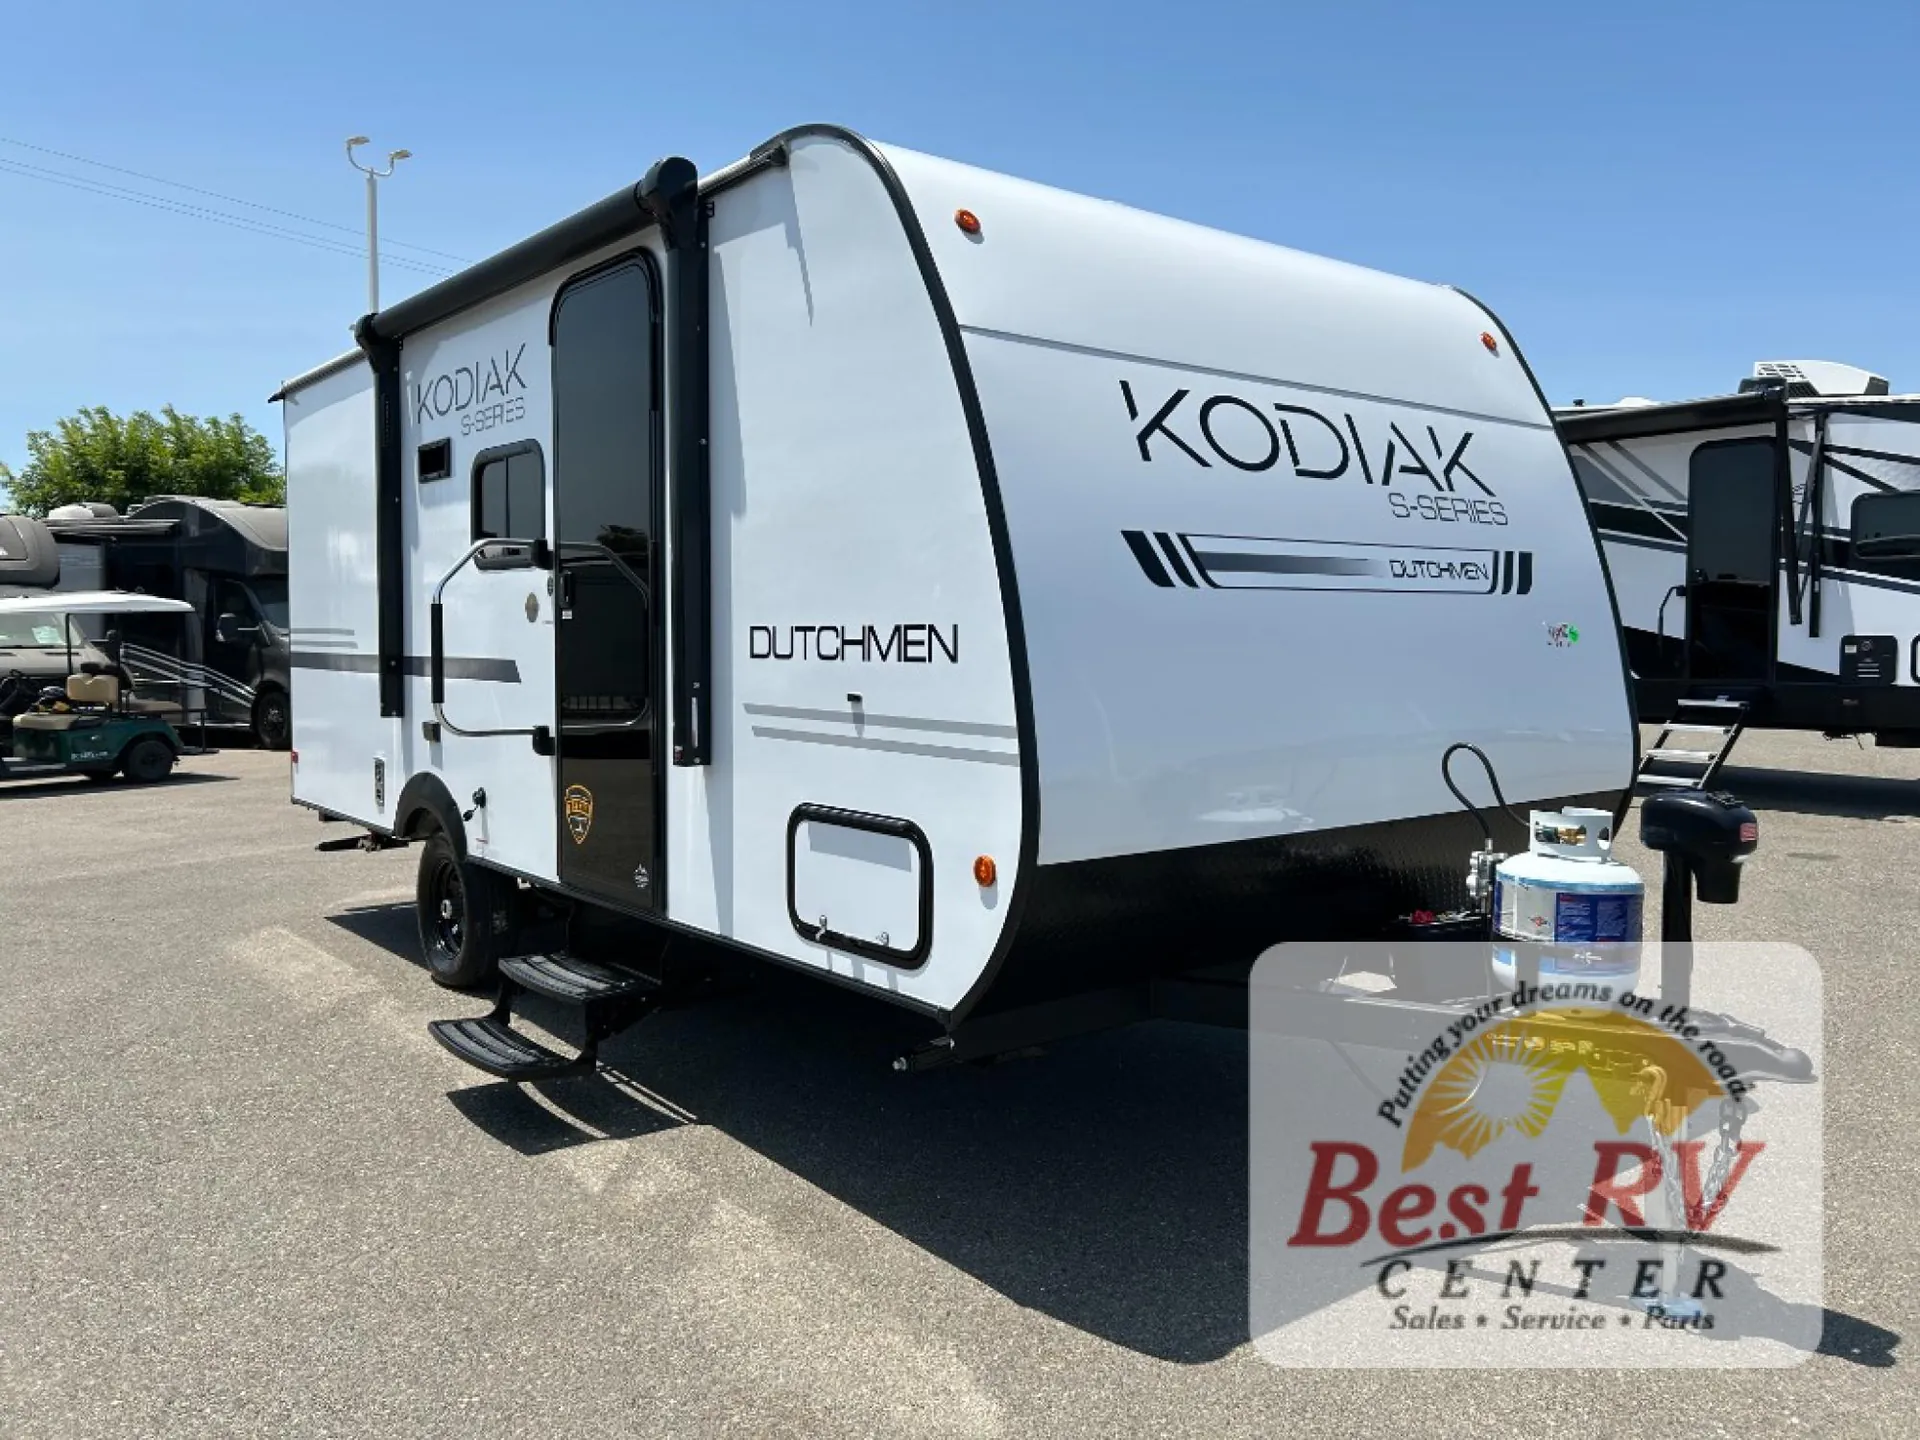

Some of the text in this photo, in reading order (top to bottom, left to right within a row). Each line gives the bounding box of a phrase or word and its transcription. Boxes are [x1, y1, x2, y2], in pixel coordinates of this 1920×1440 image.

[416, 342, 528, 424] KODIAK
[460, 396, 525, 436] S-SERIES
[1118, 379, 1497, 497] KODIAK
[1388, 492, 1508, 526] S-SERIES
[1389, 559, 1489, 580] DUTCHMEN
[749, 624, 959, 664] DUTCHMEN
